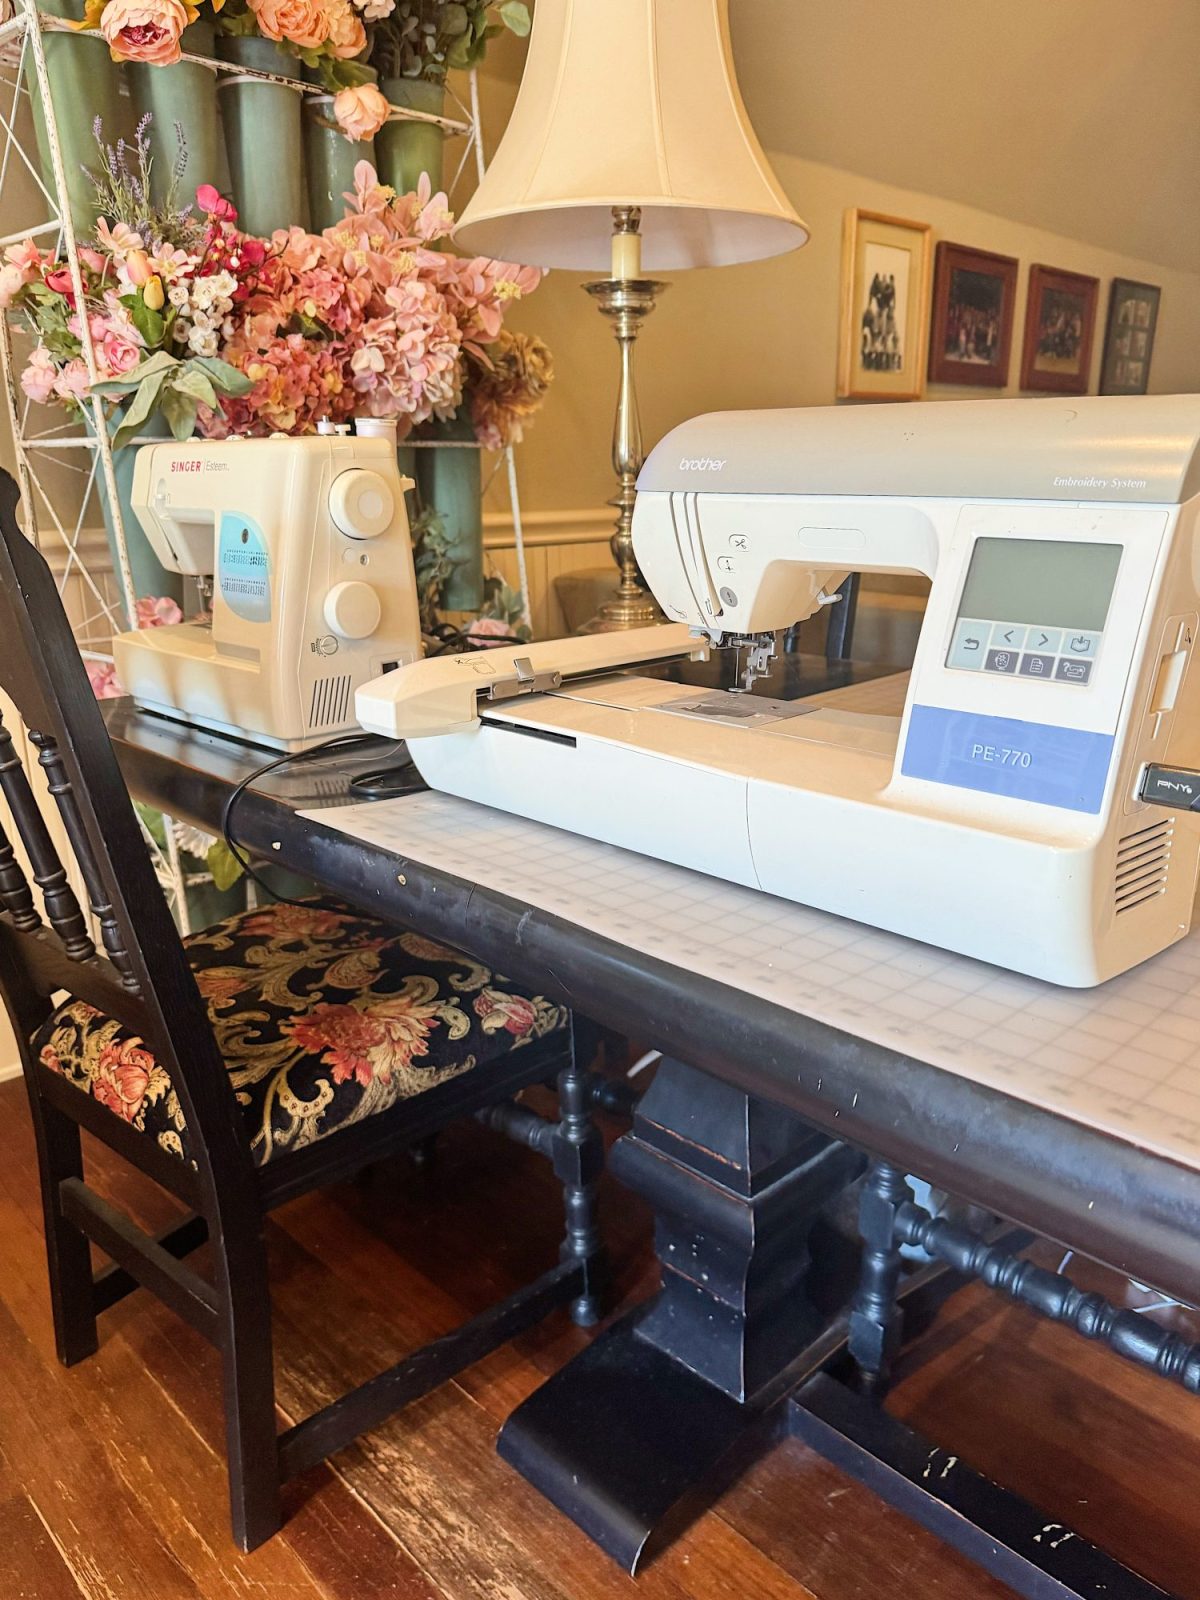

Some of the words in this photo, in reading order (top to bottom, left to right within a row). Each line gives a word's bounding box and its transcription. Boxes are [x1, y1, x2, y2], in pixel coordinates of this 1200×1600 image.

[171, 460, 201, 472] SINGER
[679, 457, 726, 472] brother
[1053, 476, 1107, 489] Embroidery
[1110, 478, 1147, 490] System
[971, 743, 1032, 768] PE-770
[1157, 779, 1190, 792] PNY
